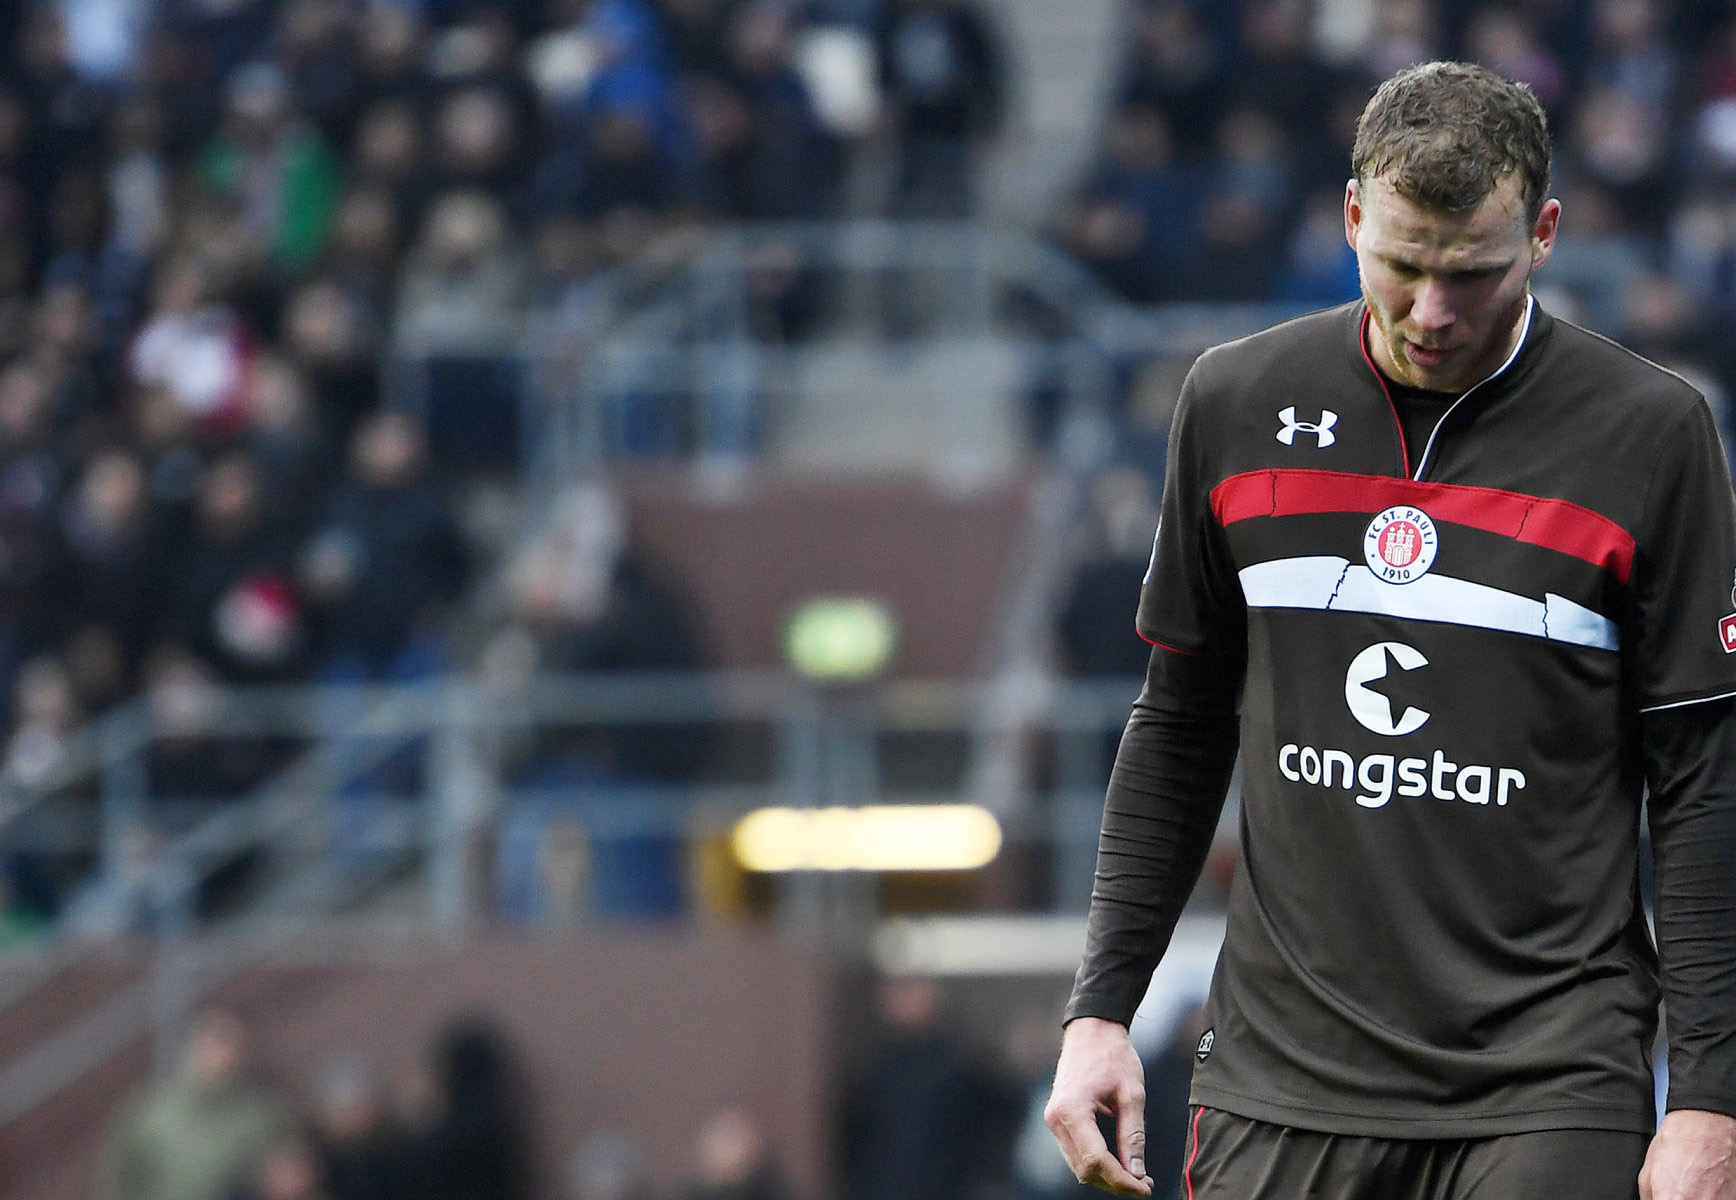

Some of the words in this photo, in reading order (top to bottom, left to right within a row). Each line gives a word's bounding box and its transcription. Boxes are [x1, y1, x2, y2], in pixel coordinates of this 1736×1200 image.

[1368, 524, 1381, 540] FC
[1382, 510, 1400, 524] ST.
[1406, 510, 1434, 545] PAULI
[1382, 567, 1410, 580] 1910
[1279, 744, 1526, 808] congstar
